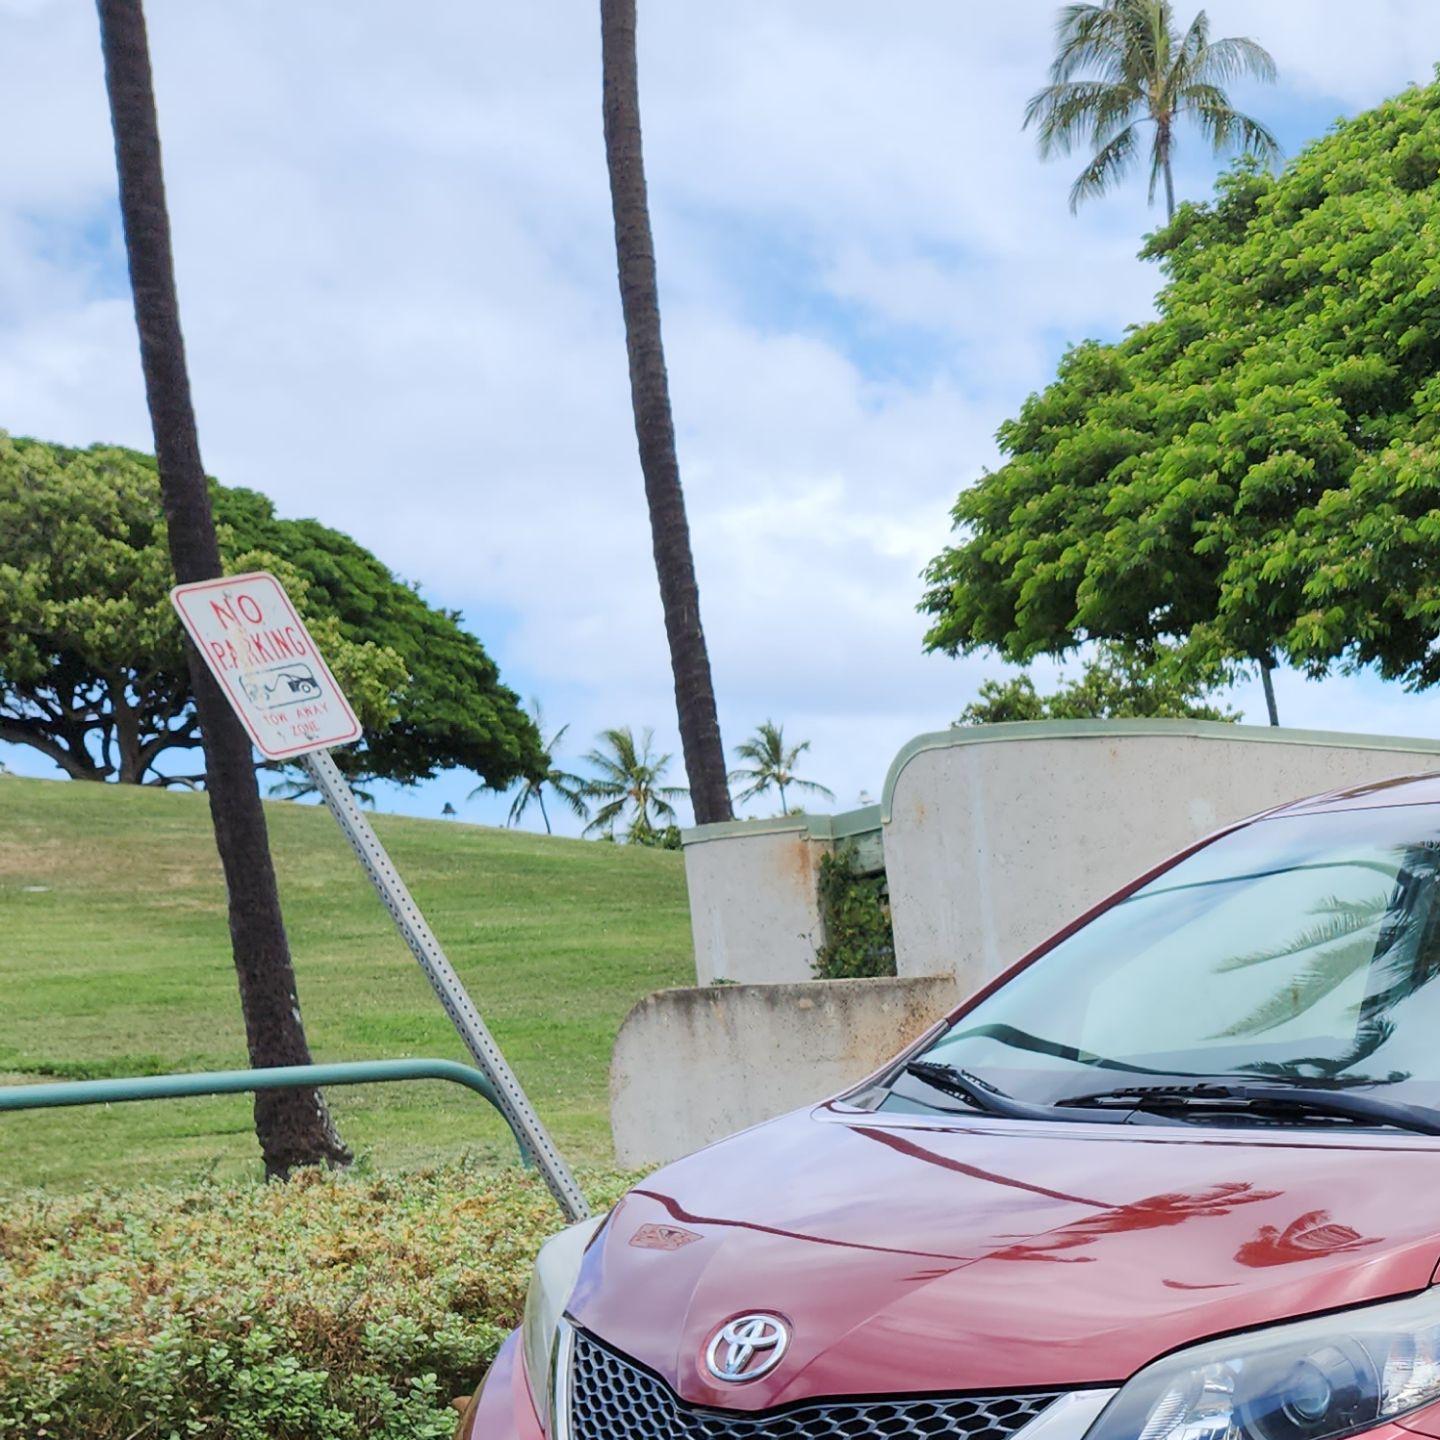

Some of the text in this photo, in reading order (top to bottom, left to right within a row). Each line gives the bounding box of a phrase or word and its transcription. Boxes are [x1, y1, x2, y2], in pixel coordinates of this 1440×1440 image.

[210, 594, 263, 630] NO
[210, 626, 307, 671] PARKING
[263, 703, 330, 727] TOW AWAY
[289, 721, 321, 737] ZONE
